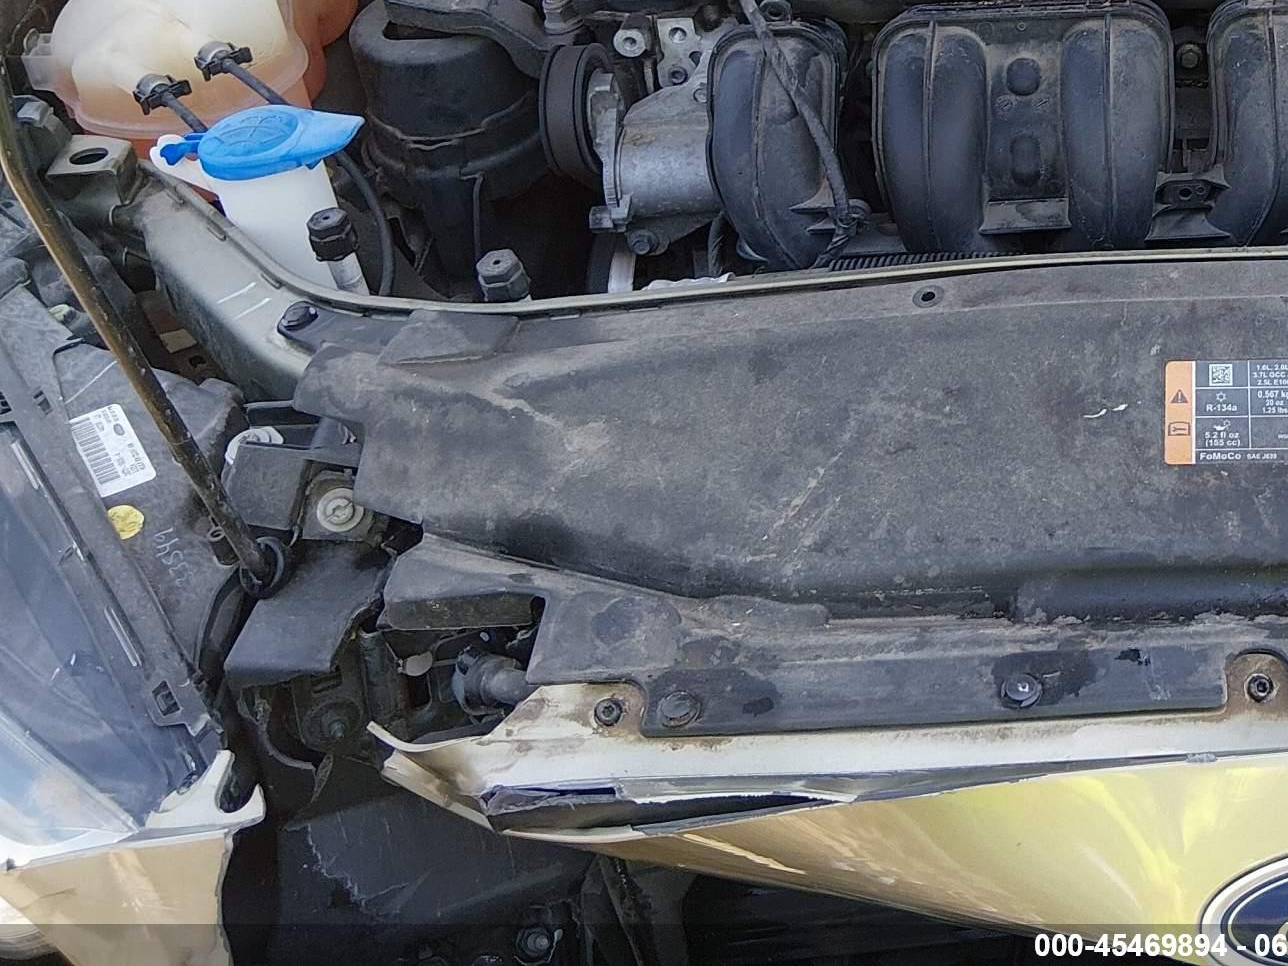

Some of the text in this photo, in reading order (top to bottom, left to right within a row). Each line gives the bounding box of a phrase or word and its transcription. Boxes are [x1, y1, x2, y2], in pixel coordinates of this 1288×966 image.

[1257, 390, 1279, 398] 0.567
[1206, 404, 1238, 412] R-134a
[1204, 431, 1218, 439] 5.2
[1205, 438, 1240, 447] (155 cc)
[1199, 452, 1241, 460] FoMoCo
